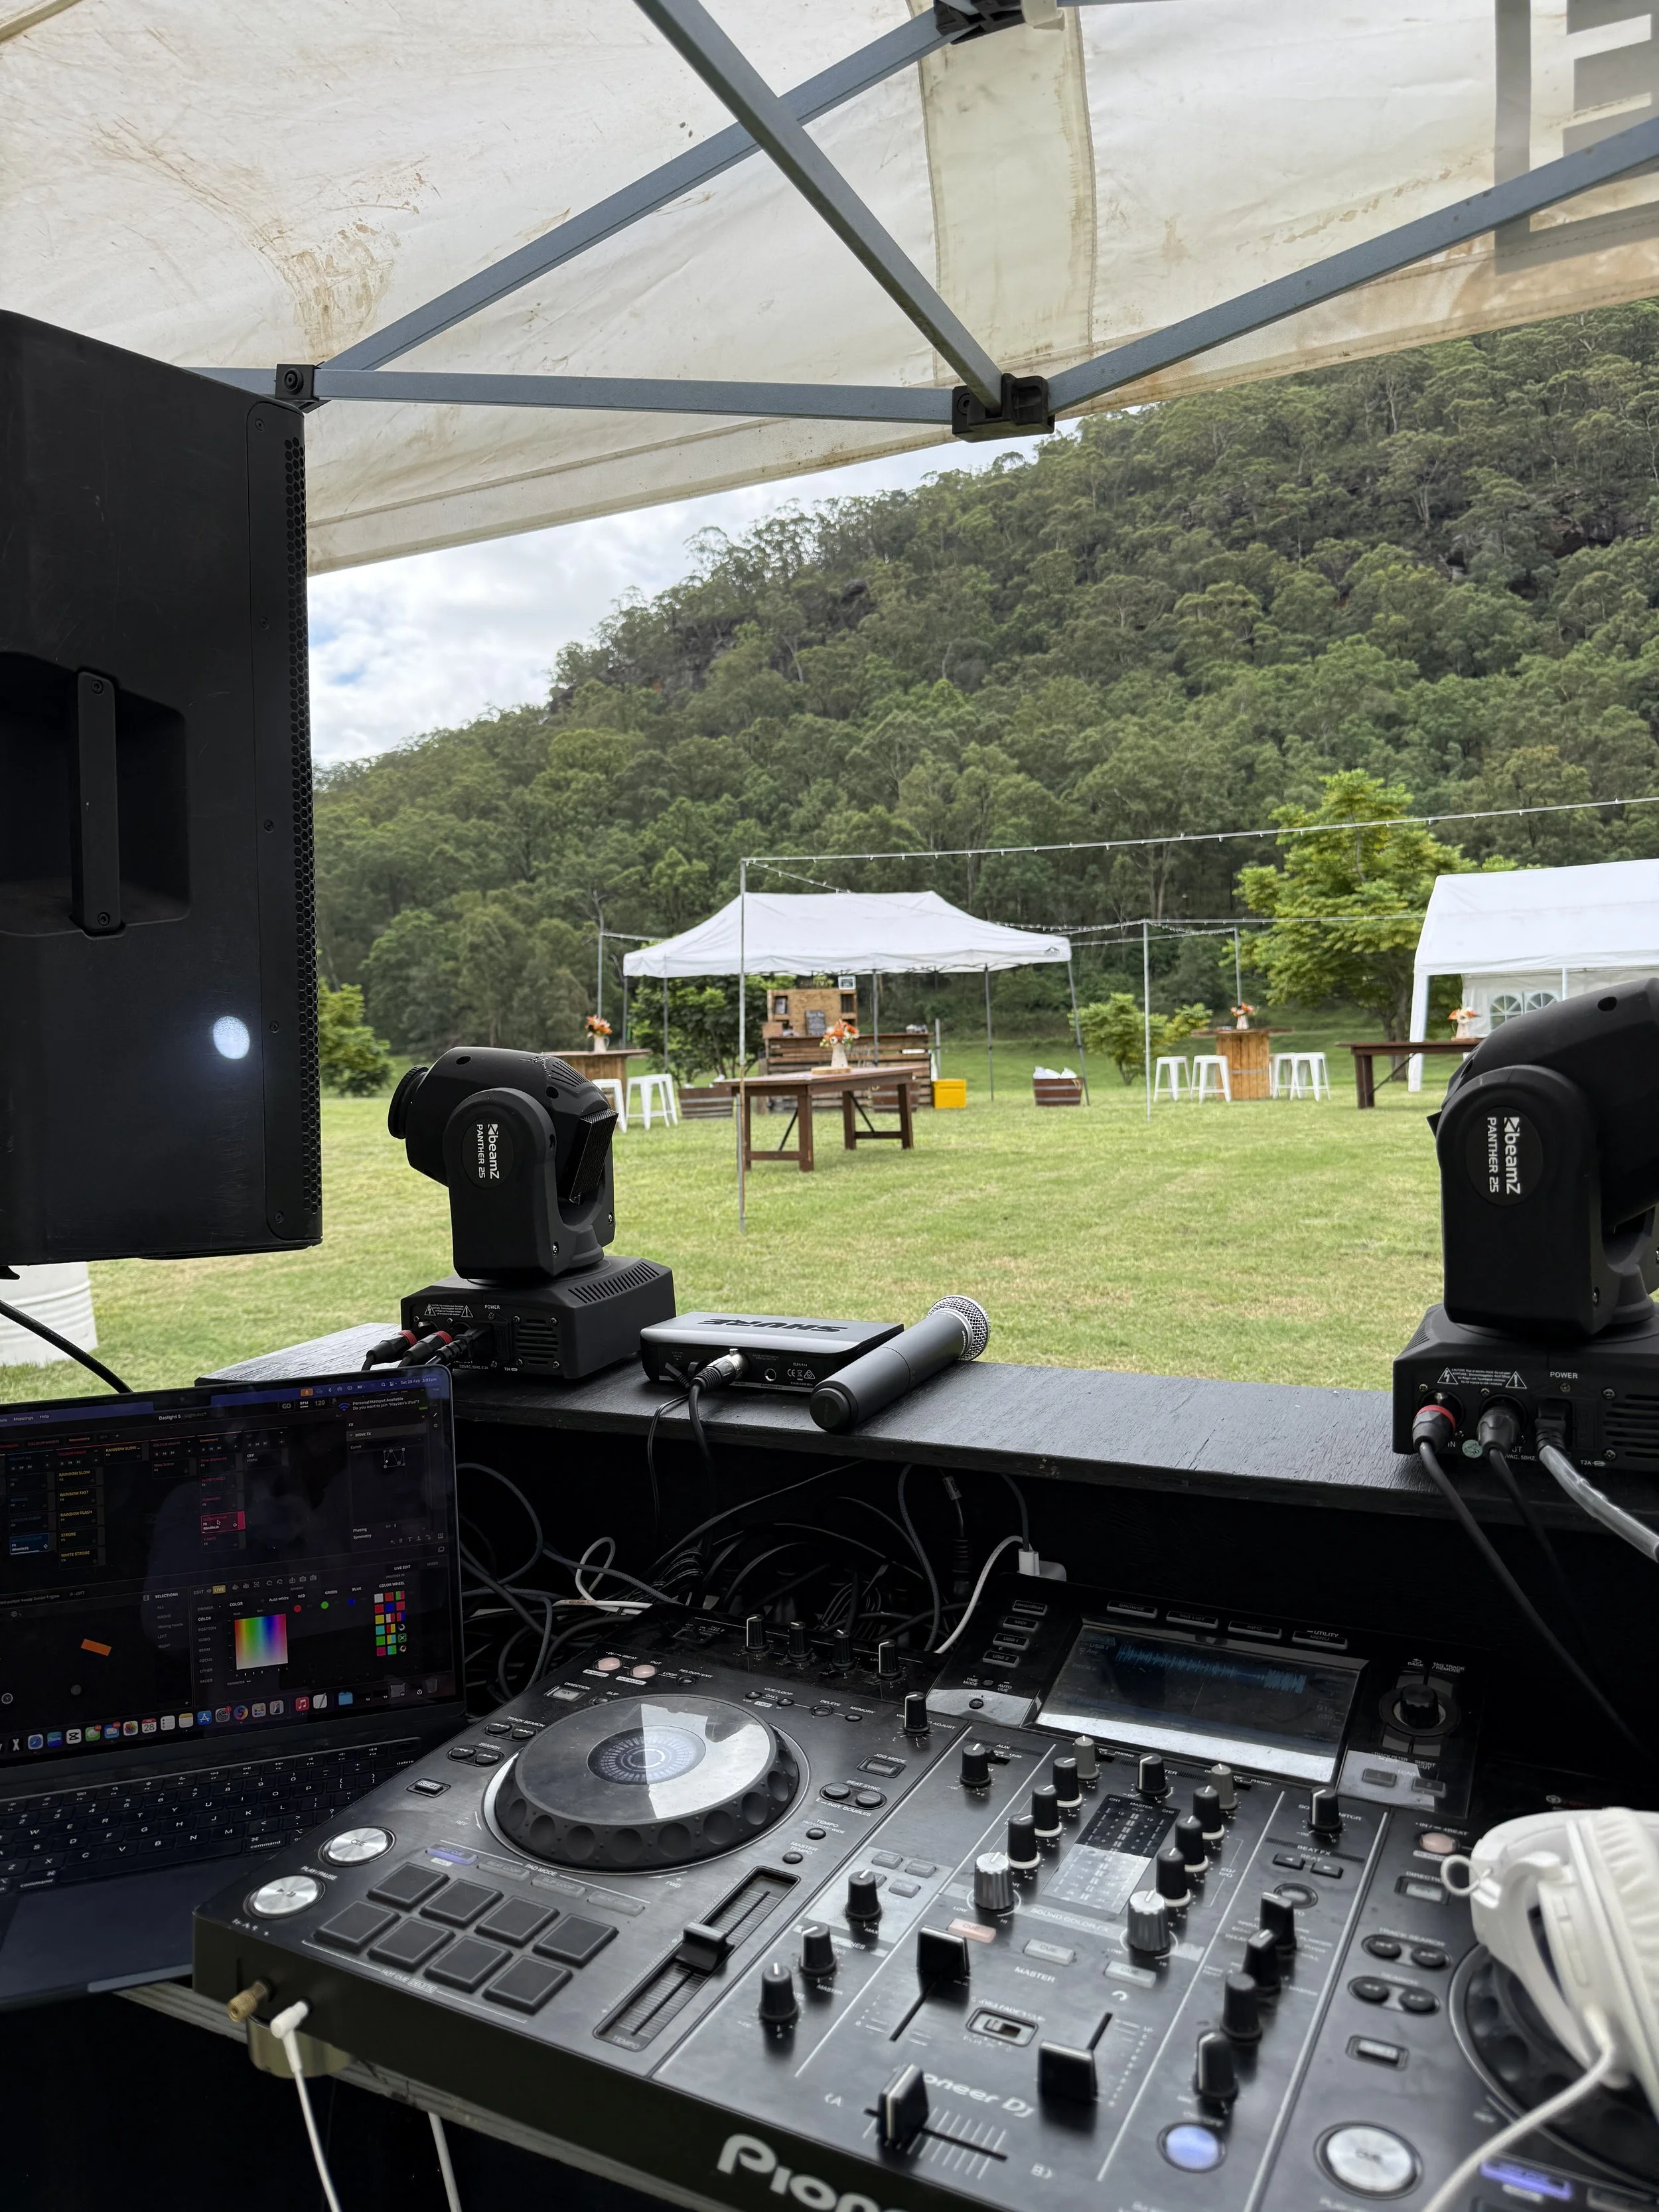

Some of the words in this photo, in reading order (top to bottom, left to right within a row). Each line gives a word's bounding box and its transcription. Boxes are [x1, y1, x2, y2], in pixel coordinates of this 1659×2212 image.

[1487, 1116, 1498, 1173] PANTHER
[488, 1135, 499, 1179] beamZ
[1504, 1133, 1520, 1195] beamZ
[478, 1166, 486, 1179] 25
[1489, 1177, 1499, 1193] 25
[697, 1318, 849, 1333] SHURE
[1313, 1629, 1339, 1639] UTILITY
[679, 1668, 714, 1679] RELOOP/EXIT
[563, 1682, 591, 1690] DIRECTION
[764, 1686, 794, 1696] CUE/LOOP
[820, 1698, 842, 1707] DELETE
[849, 1706, 876, 1714] MEMORY
[144, 1723, 155, 1732] 28
[523, 1719, 545, 1728] SEARCH
[1129, 1801, 1153, 1810] MASTER
[842, 1807, 872, 1817] DOUBLES
[1338, 1812, 1363, 1822] NITOR
[816, 1818, 839, 1828] TEMPO
[250, 1840, 281, 1850] command
[350, 1838, 366, 1848] CUE
[790, 1841, 819, 1852] MASTER
[789, 1846, 814, 1856] TEMPO
[1297, 1844, 1319, 1854] BEAT
[1300, 1853, 1323, 1862] BEAT
[300, 1865, 339, 1882] PLAY/PAUSE
[525, 1864, 538, 1872] PAD
[538, 1867, 557, 1877] MODE
[665, 1880, 682, 1889] FWD
[953, 1904, 968, 1913] LOW
[1029, 1908, 1062, 1923] SOUND
[1063, 1915, 1095, 1929] COLOR
[1094, 1923, 1110, 1934] FX
[380, 1969, 396, 1980] HOT
[395, 1974, 410, 1984] CUE
[1014, 1966, 1056, 1984] MASTER
[922, 2072, 999, 2104] oneer
[1001, 2097, 1036, 2118] DJ
